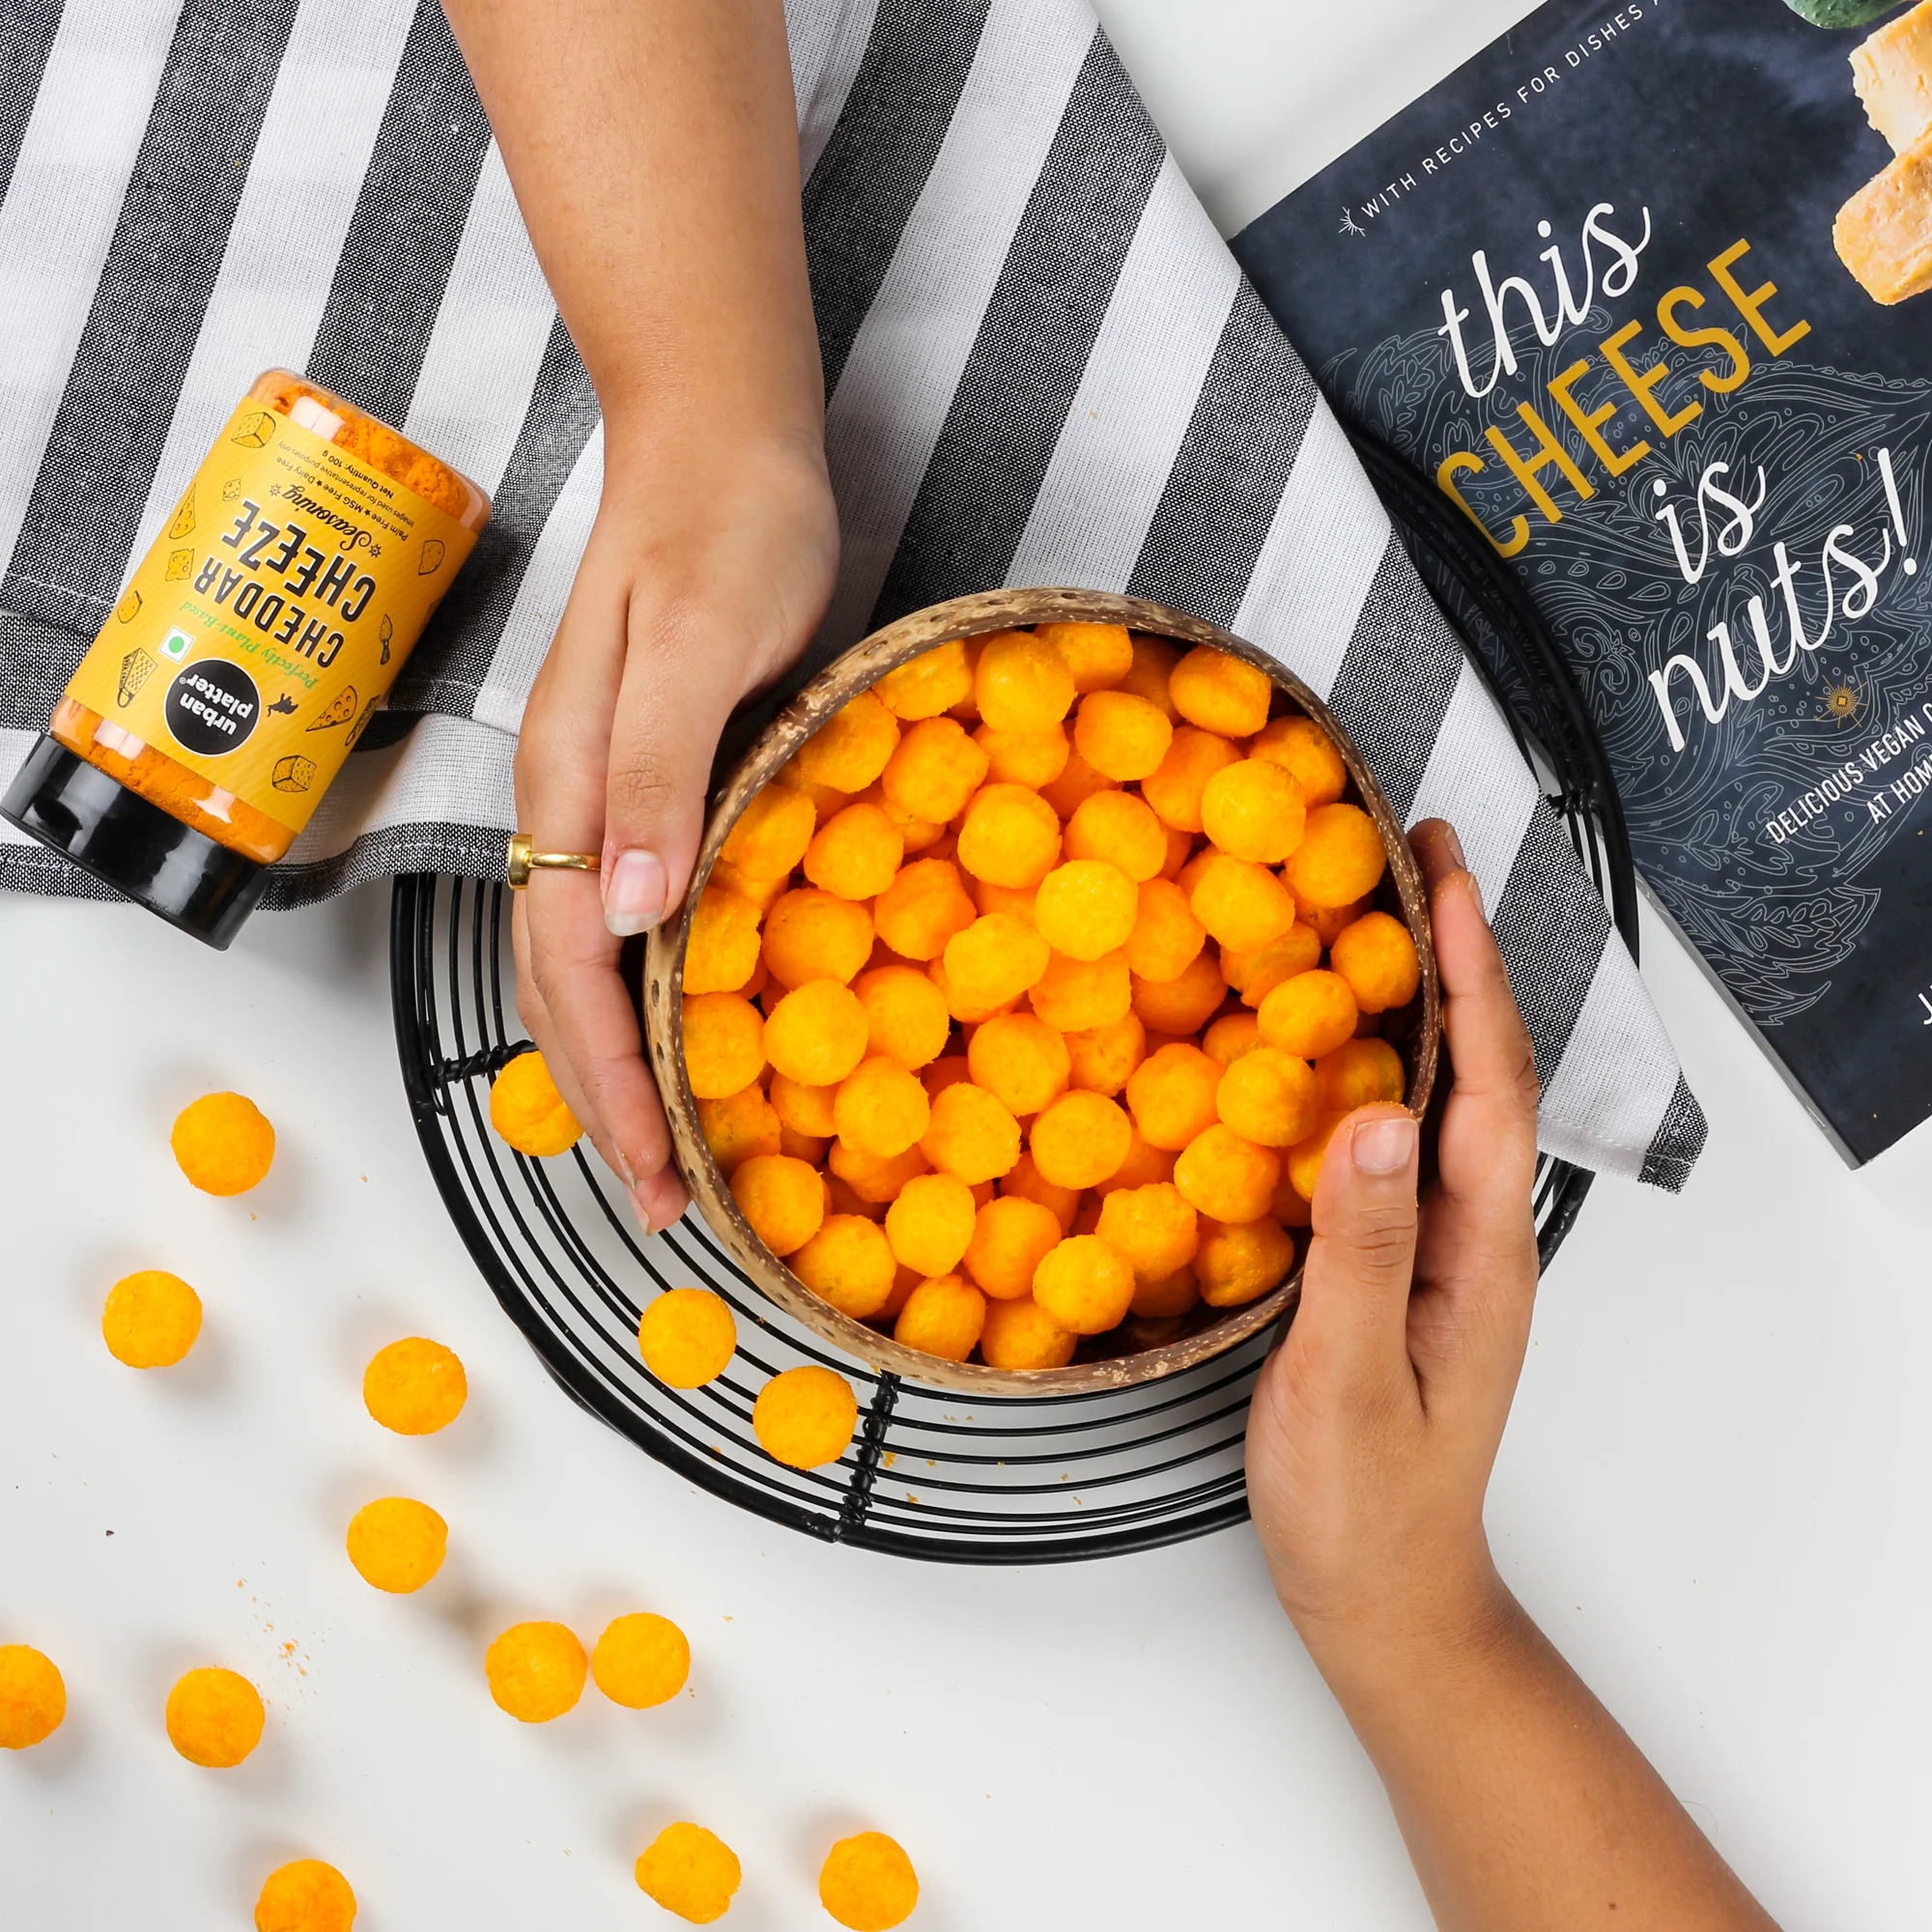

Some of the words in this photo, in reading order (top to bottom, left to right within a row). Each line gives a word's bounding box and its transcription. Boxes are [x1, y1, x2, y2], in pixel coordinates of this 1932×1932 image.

[1360, 173, 1417, 218] WITH
[1421, 102, 1512, 175] RECIPES
[1517, 67, 1560, 103] FOR
[1565, 4, 1642, 68] DISHES
[1437, 203, 1651, 398] this
[1436, 238, 1811, 558] CHEESE
[276, 456, 294, 471] Free
[294, 466, 316, 484] Dairy
[320, 466, 367, 497] representative
[327, 455, 342, 468] 100
[323, 484, 343, 500] Free
[342, 496, 363, 513] MSG
[366, 494, 378, 504] for
[375, 499, 393, 513] used
[379, 485, 394, 498] Net
[281, 484, 372, 551] Seasoning
[370, 513, 389, 529] Free
[389, 525, 409, 541] Palm
[1653, 461, 1766, 583] is
[221, 500, 376, 622] CHEEZE
[194, 556, 344, 668] CHEDDAR
[1648, 447, 1918, 753] nuts!
[182, 602, 259, 653] Plant-Based
[262, 648, 317, 688] Perfectly
[180, 692, 237, 734] urban
[1765, 761, 1864, 844] DELICIOUS
[1859, 715, 1925, 771] VEGAN
[1866, 792, 1892, 824] AT
[1890, 754, 1932, 804] HOM
